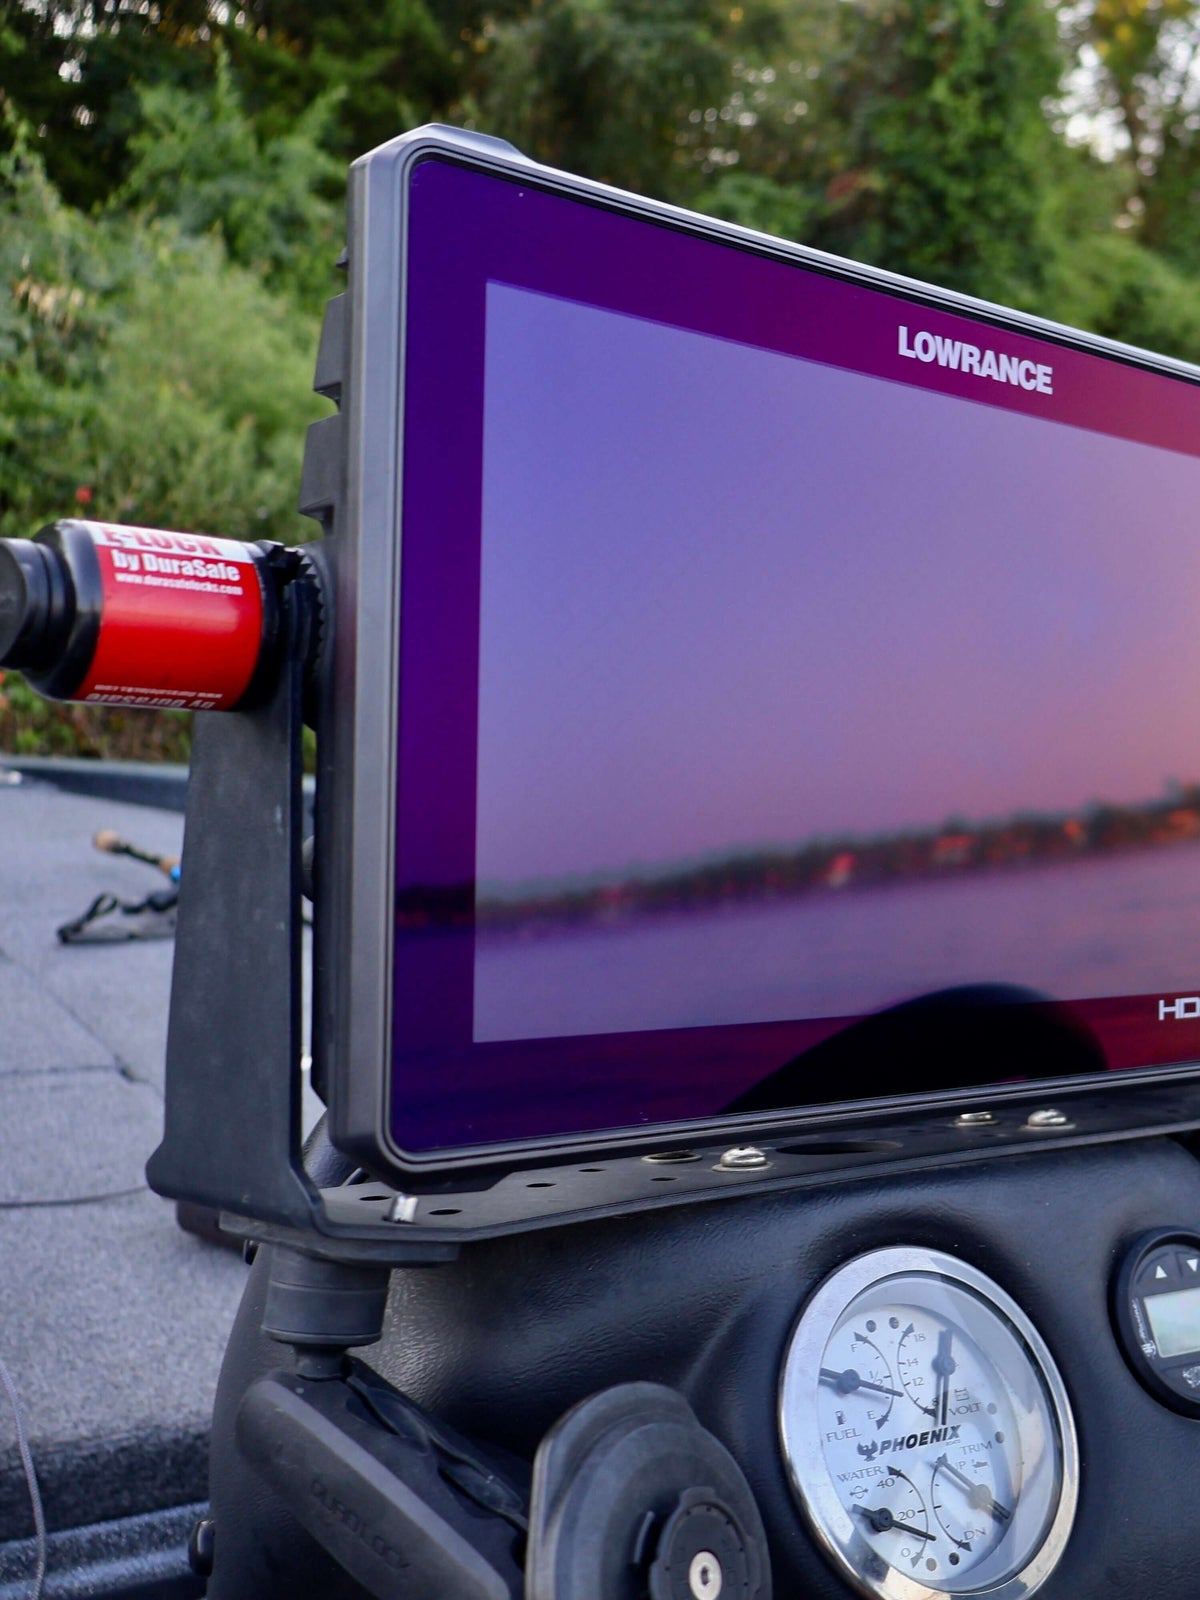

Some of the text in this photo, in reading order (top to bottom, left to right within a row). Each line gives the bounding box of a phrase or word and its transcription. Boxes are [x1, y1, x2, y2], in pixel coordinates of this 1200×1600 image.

[898, 325, 1054, 396] LOWRANCE
[111, 549, 241, 582] by DuraSafe
[948, 1402, 982, 1416] VOLT
[826, 1428, 862, 1443] FUEL
[879, 1425, 961, 1455] PHOENIX
[960, 1440, 993, 1455] TRIM
[836, 1466, 884, 1483] WATER
[876, 1477, 896, 1489] 40
[897, 1508, 916, 1522] 20
[963, 1527, 987, 1541] DN
